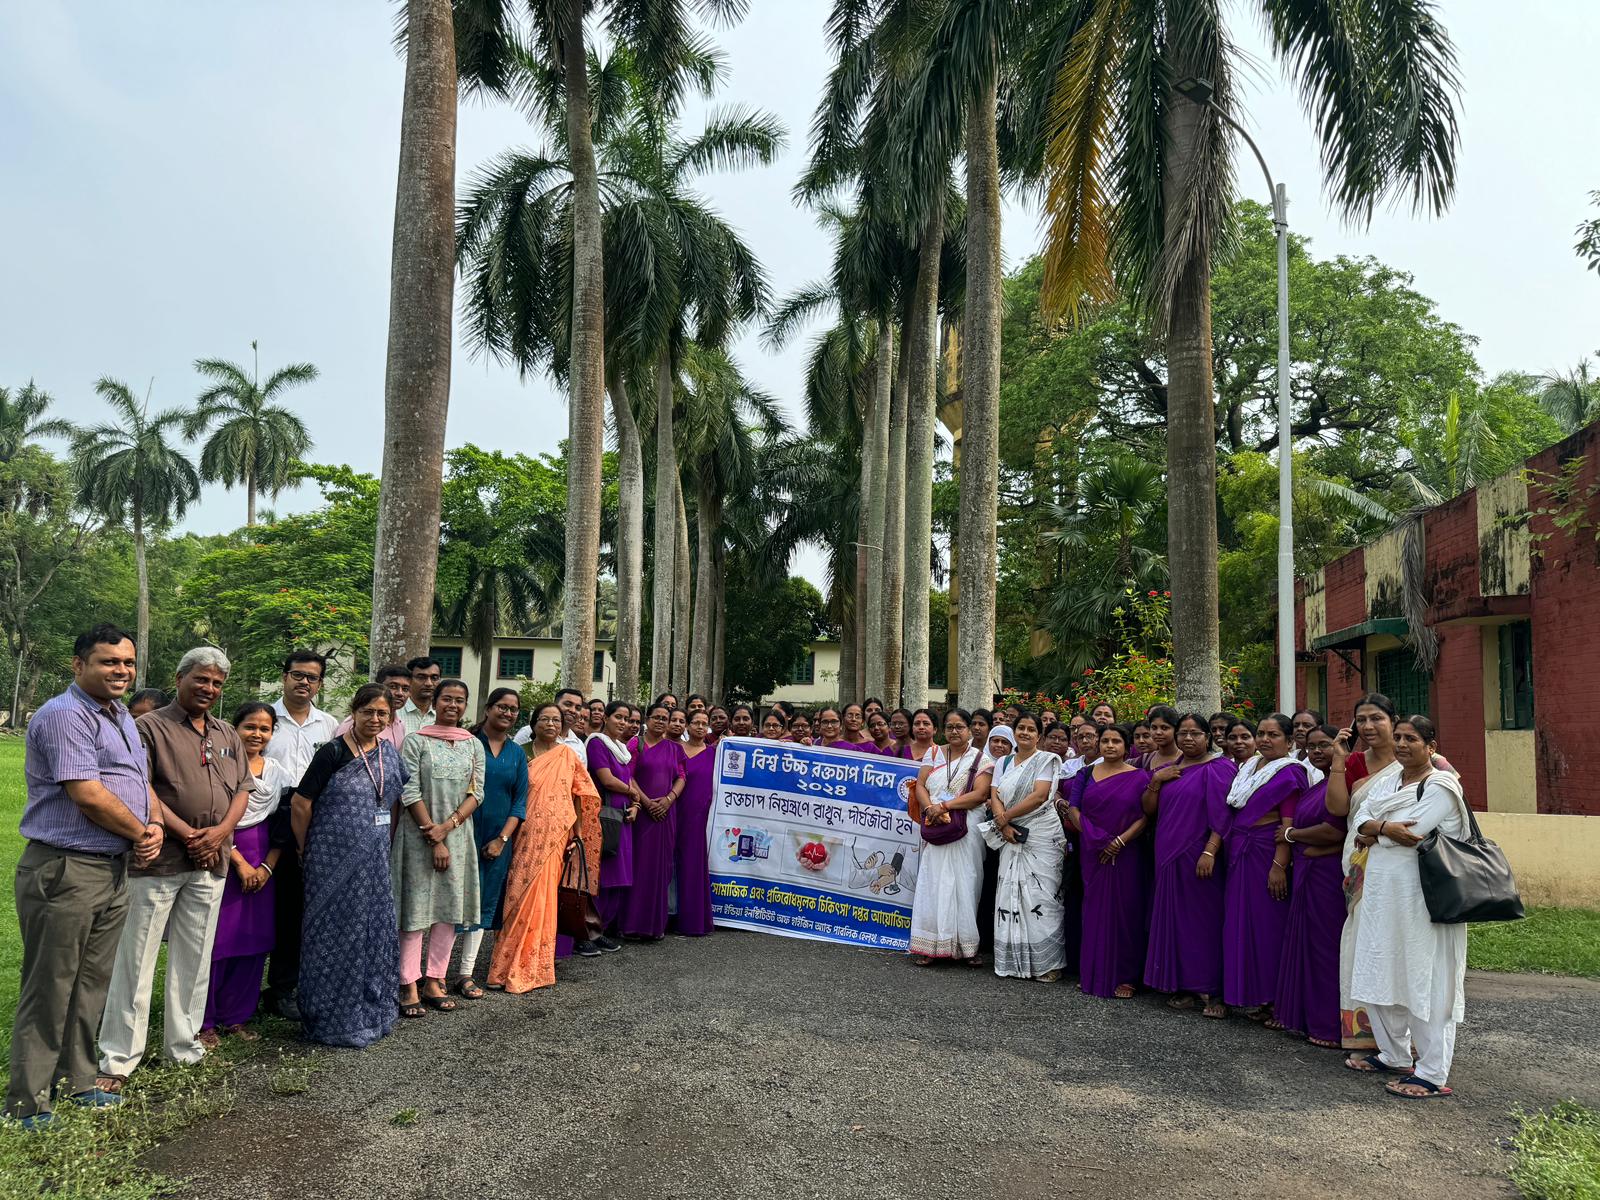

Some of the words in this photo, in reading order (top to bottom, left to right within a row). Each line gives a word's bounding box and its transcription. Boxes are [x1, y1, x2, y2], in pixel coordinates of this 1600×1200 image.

[751, 748, 779, 773] বিশ্ব
[782, 753, 810, 775] উচ্চ
[811, 761, 860, 784] রক্তচাপ
[862, 764, 897, 789] দিবস
[796, 779, 848, 796] ২০২৪
[724, 791, 766, 810] রক্তচাপ
[768, 793, 810, 818] নিয়ন্ত্রণে
[848, 805, 893, 832] দীর্ঘজীবী
[895, 817, 913, 836] হন
[749, 886, 765, 900] এবং
[766, 886, 818, 912] প্রতিরোধমূলক
[870, 909, 912, 929] আয়োজিত
